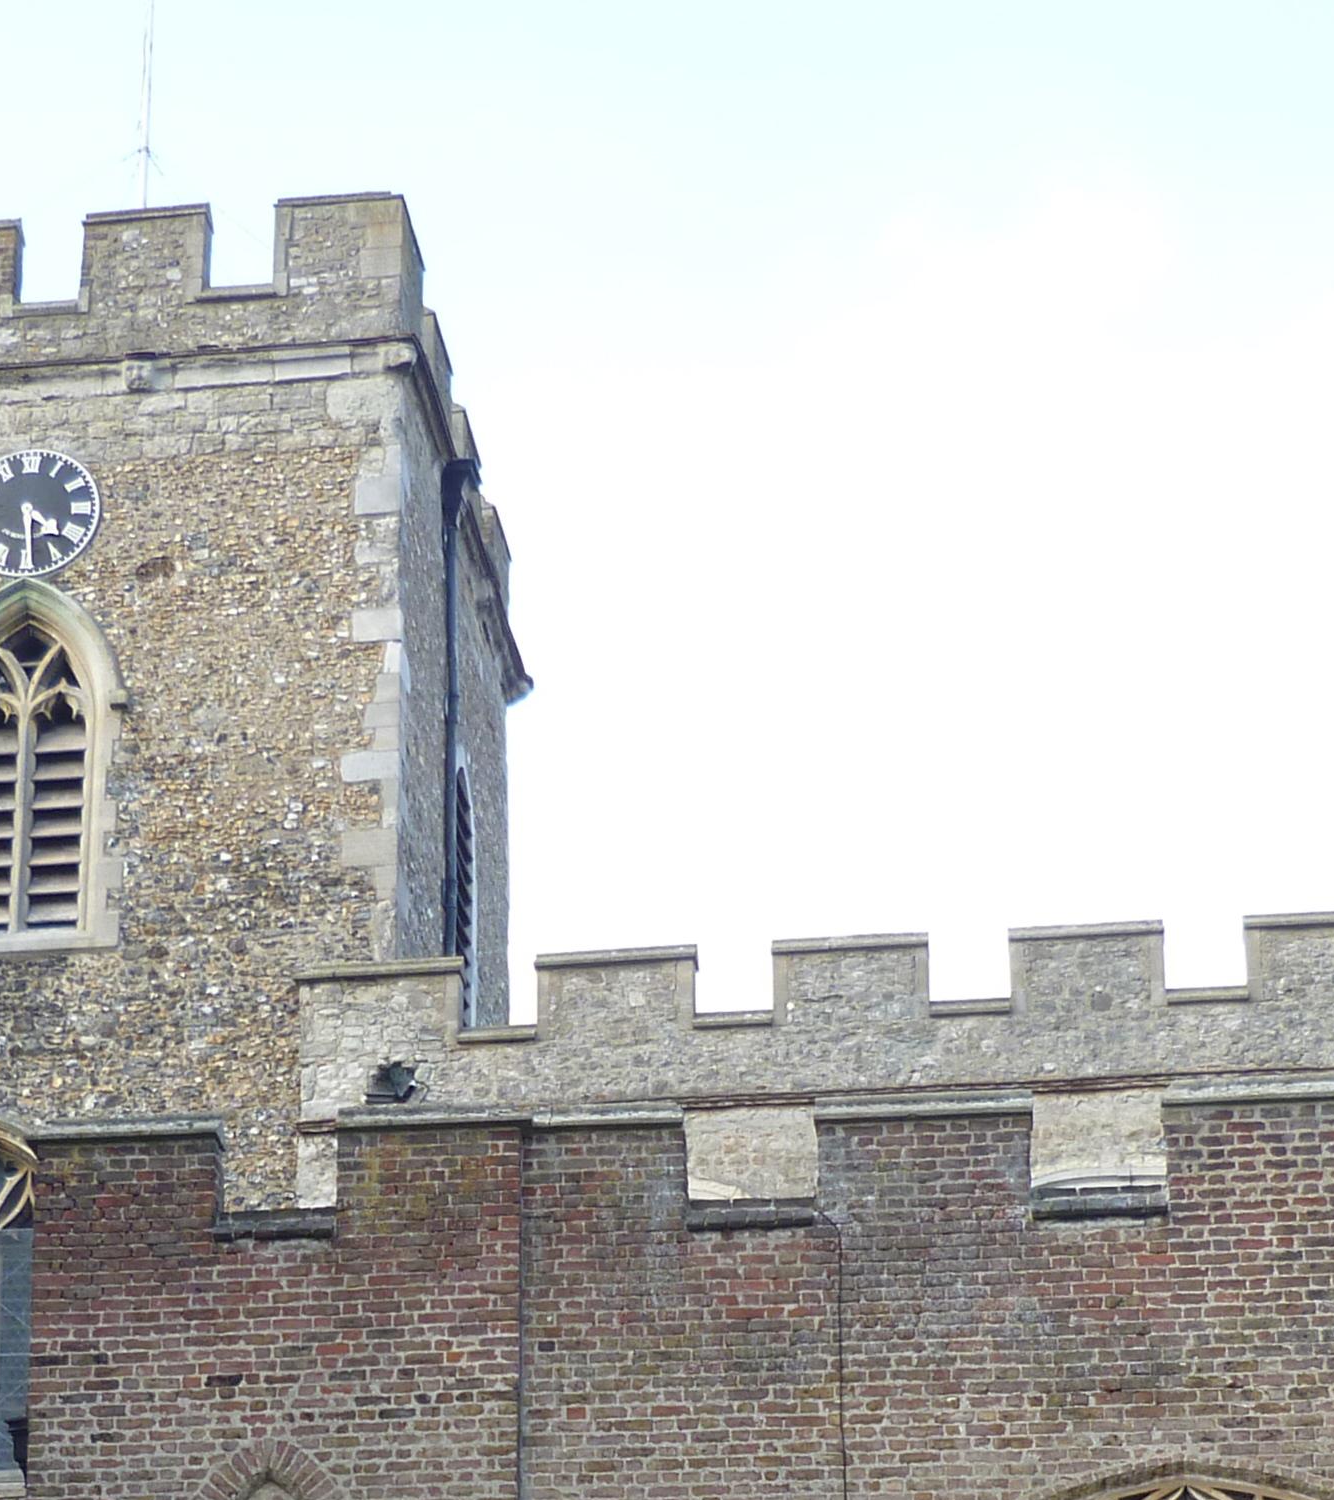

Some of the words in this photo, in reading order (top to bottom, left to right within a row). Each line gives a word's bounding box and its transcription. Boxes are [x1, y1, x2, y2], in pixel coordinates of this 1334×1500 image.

[22, 456, 42, 474] XII
[49, 460, 64, 478] I
[64, 477, 85, 493] II
[71, 501, 91, 515] III
[47, 541, 63, 561] V
